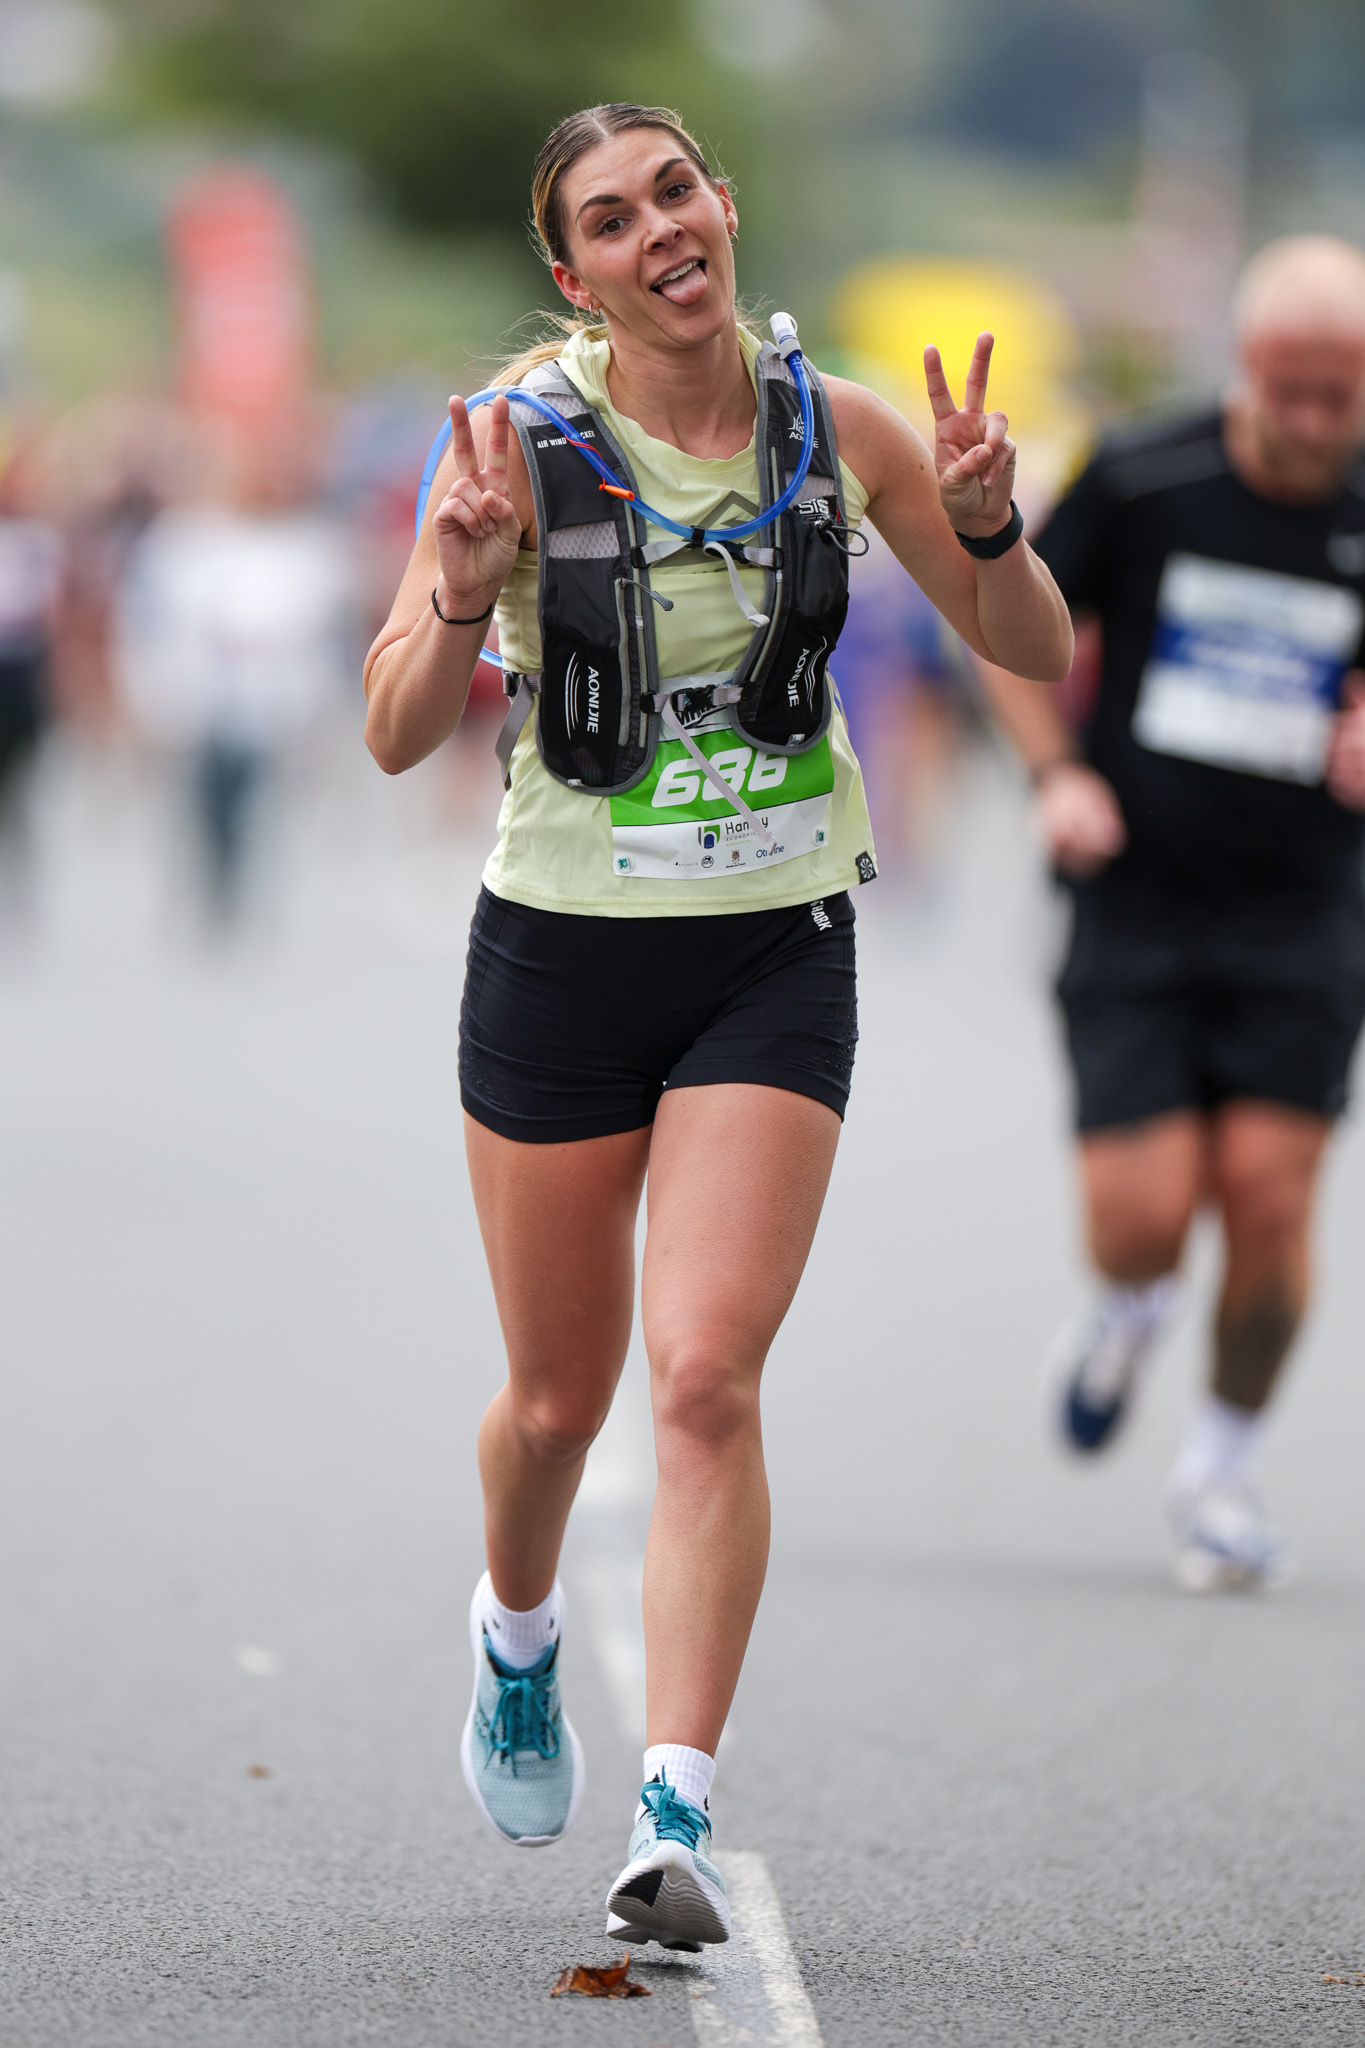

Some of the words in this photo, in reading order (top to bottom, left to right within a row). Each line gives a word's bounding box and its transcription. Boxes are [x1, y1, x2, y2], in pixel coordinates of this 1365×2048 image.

[537, 439, 549, 448] AIR
[549, 437, 567, 446] WIND
[786, 648, 810, 707] AONIJIE
[586, 665, 600, 734] AONIJIE
[651, 746, 788, 808] 686
[725, 816, 769, 834] Hany
[756, 845, 785, 858] Otine
